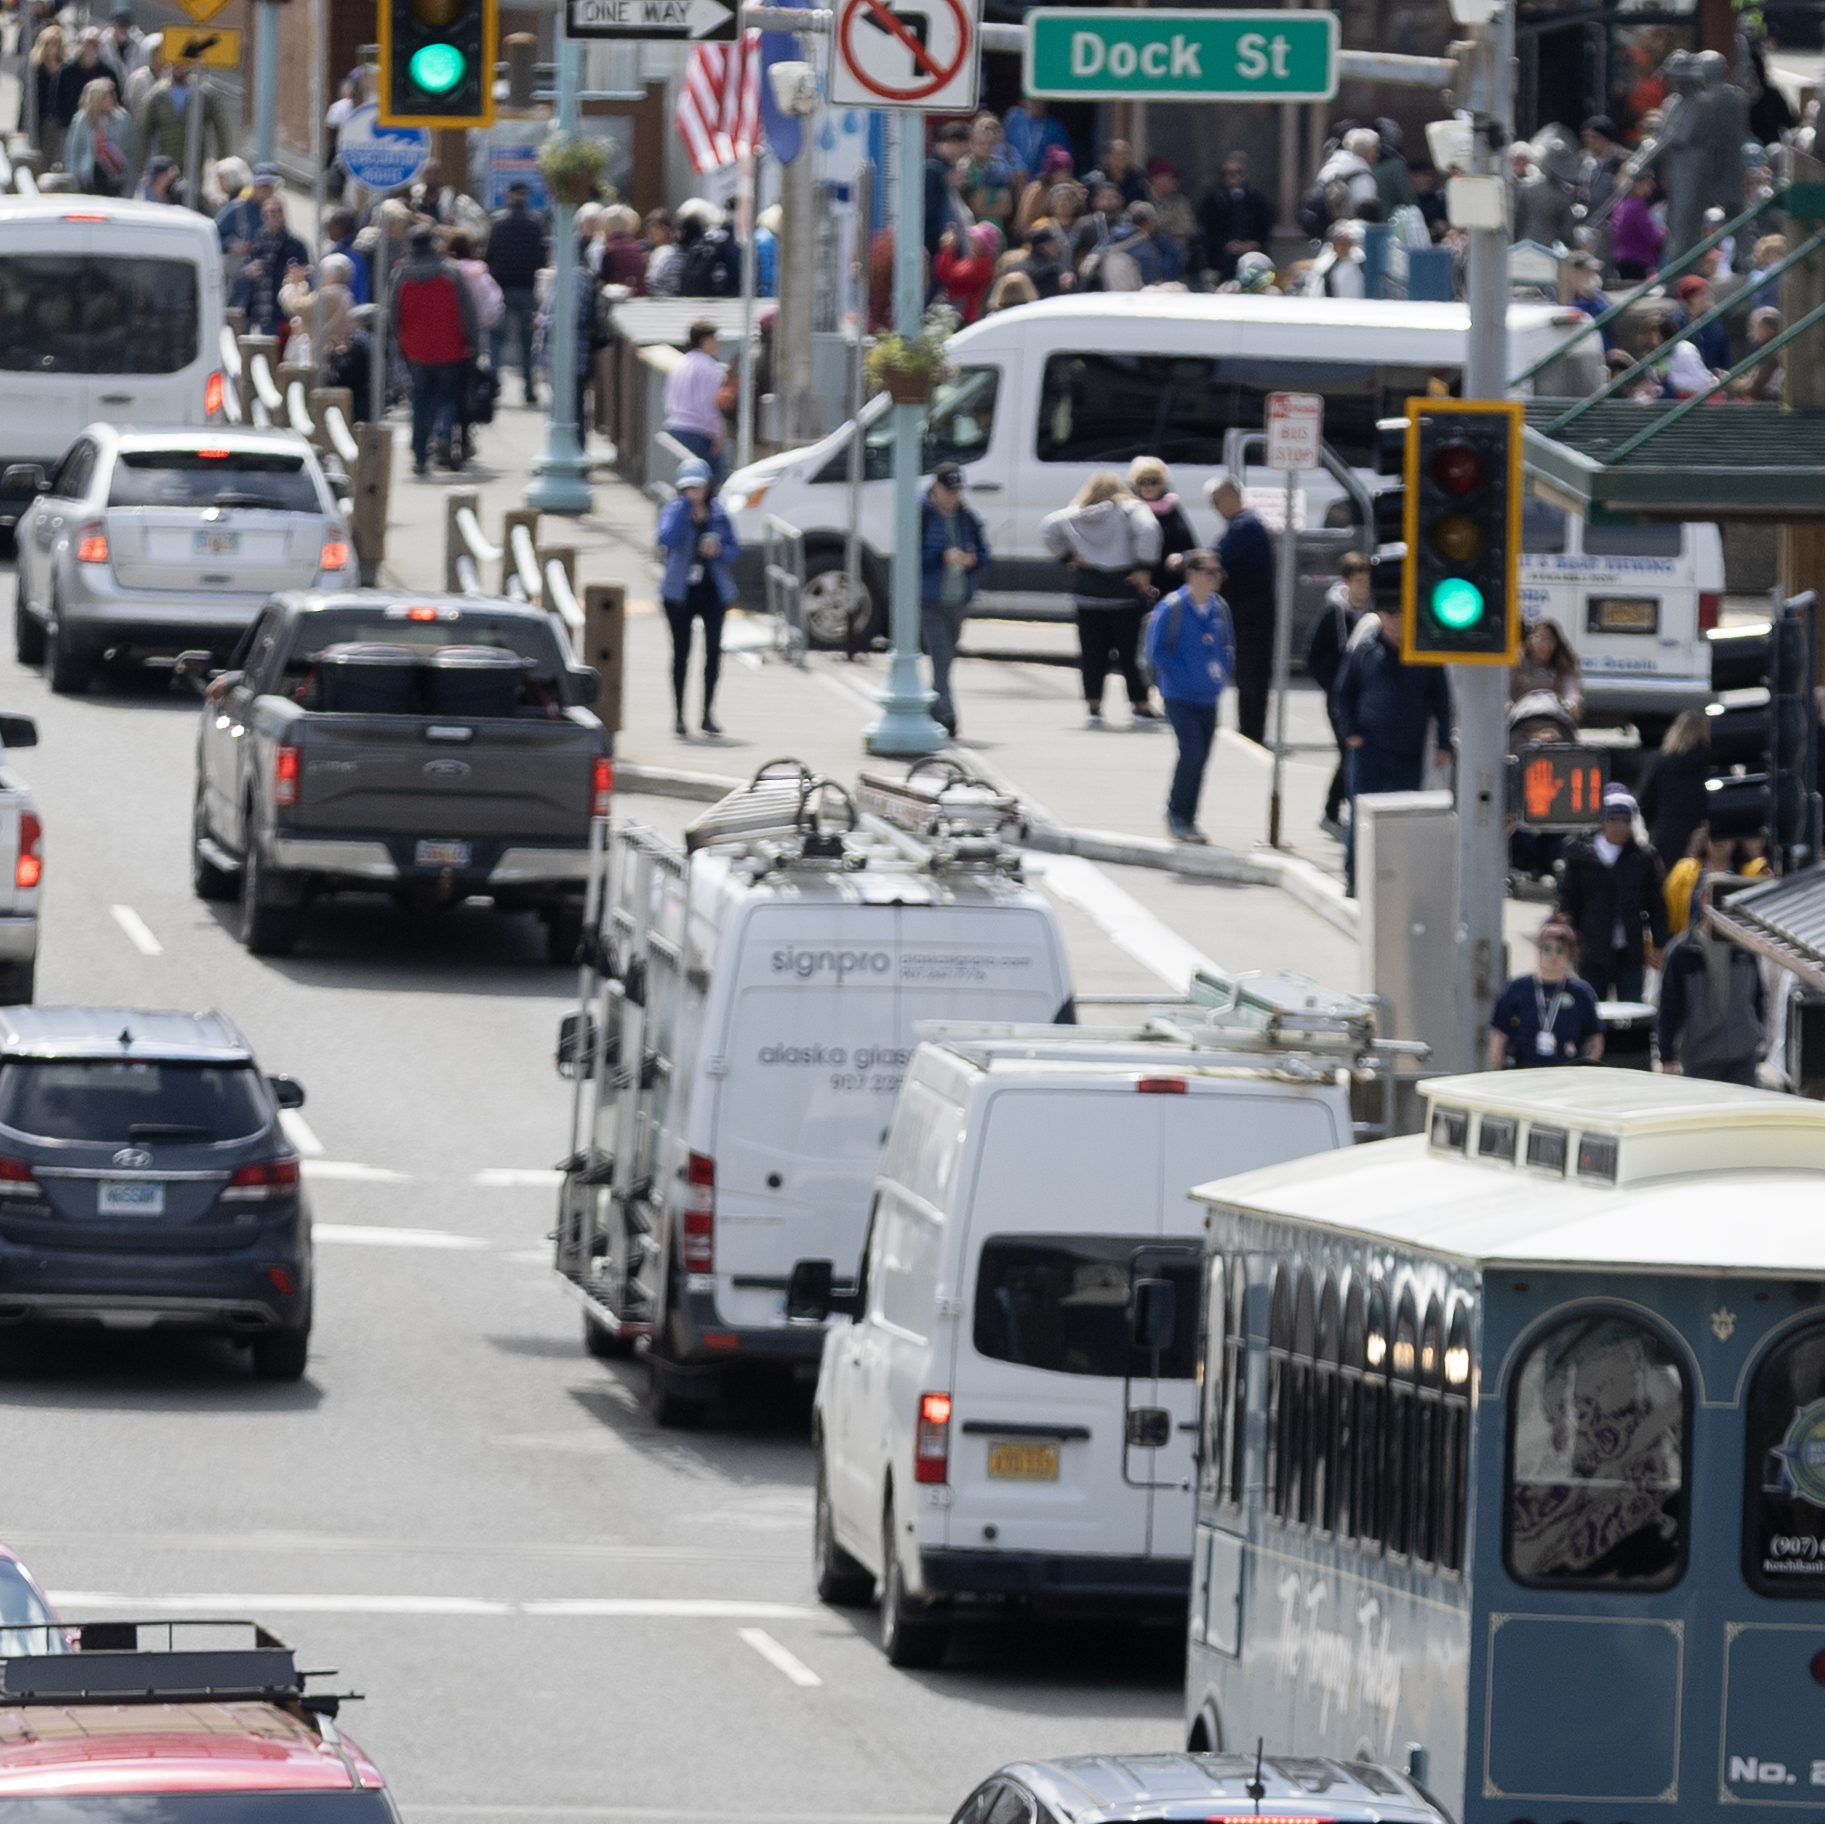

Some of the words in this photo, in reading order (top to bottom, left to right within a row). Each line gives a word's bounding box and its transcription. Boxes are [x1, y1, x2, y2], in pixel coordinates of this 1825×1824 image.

[584, 1, 628, 23] ONE
[641, 1, 691, 24] WAY
[1071, 31, 1204, 79] Dock
[1234, 32, 1293, 80] St
[1280, 426, 1309, 440] BUS
[771, 945, 891, 983] signpro
[758, 1042, 847, 1067] alaska
[1770, 1534, 1819, 1561] (907)
[1729, 1755, 1798, 1786] No.
